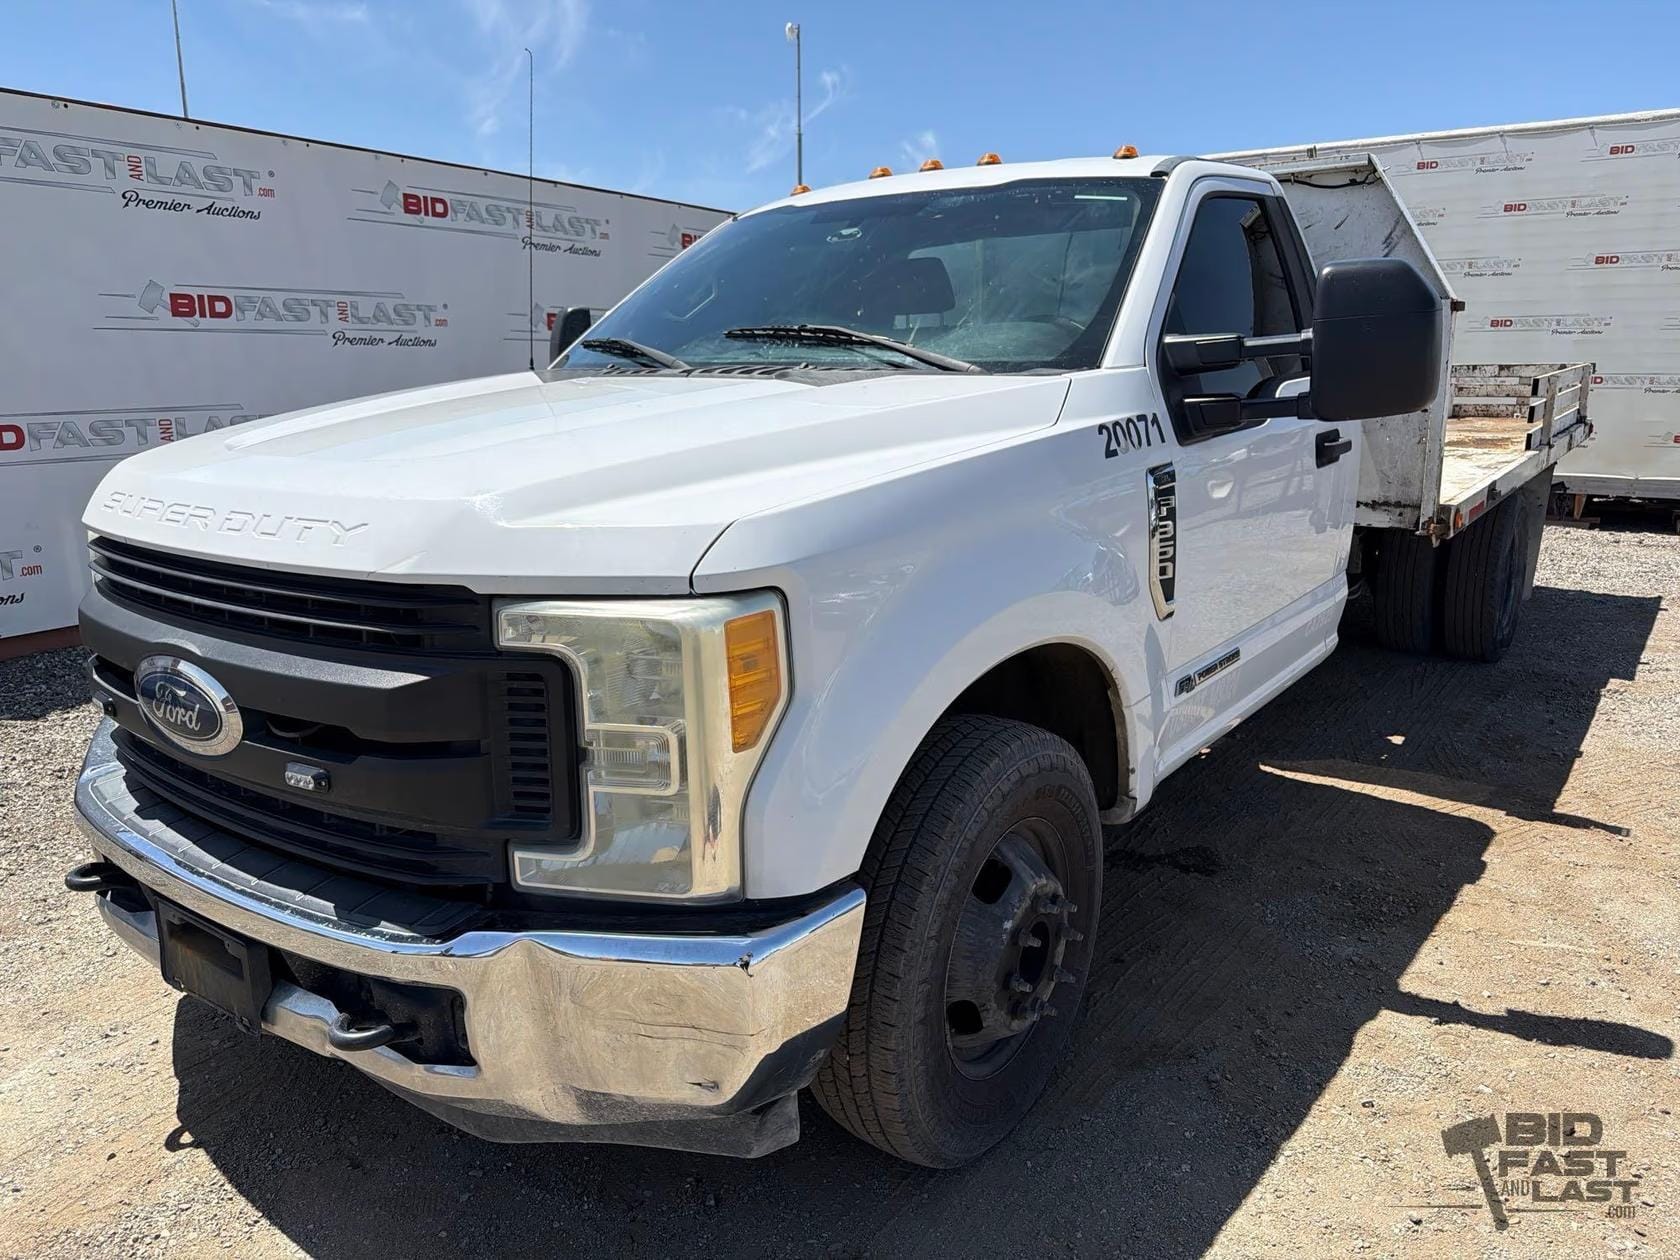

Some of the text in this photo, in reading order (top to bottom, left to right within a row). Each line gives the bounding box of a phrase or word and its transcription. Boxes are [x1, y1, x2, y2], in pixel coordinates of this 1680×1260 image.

[121, 190, 261, 220] Premier Auctions
[332, 330, 437, 347] Premier Auctions
[1098, 412, 1166, 459] 20071
[101, 491, 369, 547] SUPER DUTY
[20, 565, 43, 577] .com
[152, 681, 201, 732] Ford
